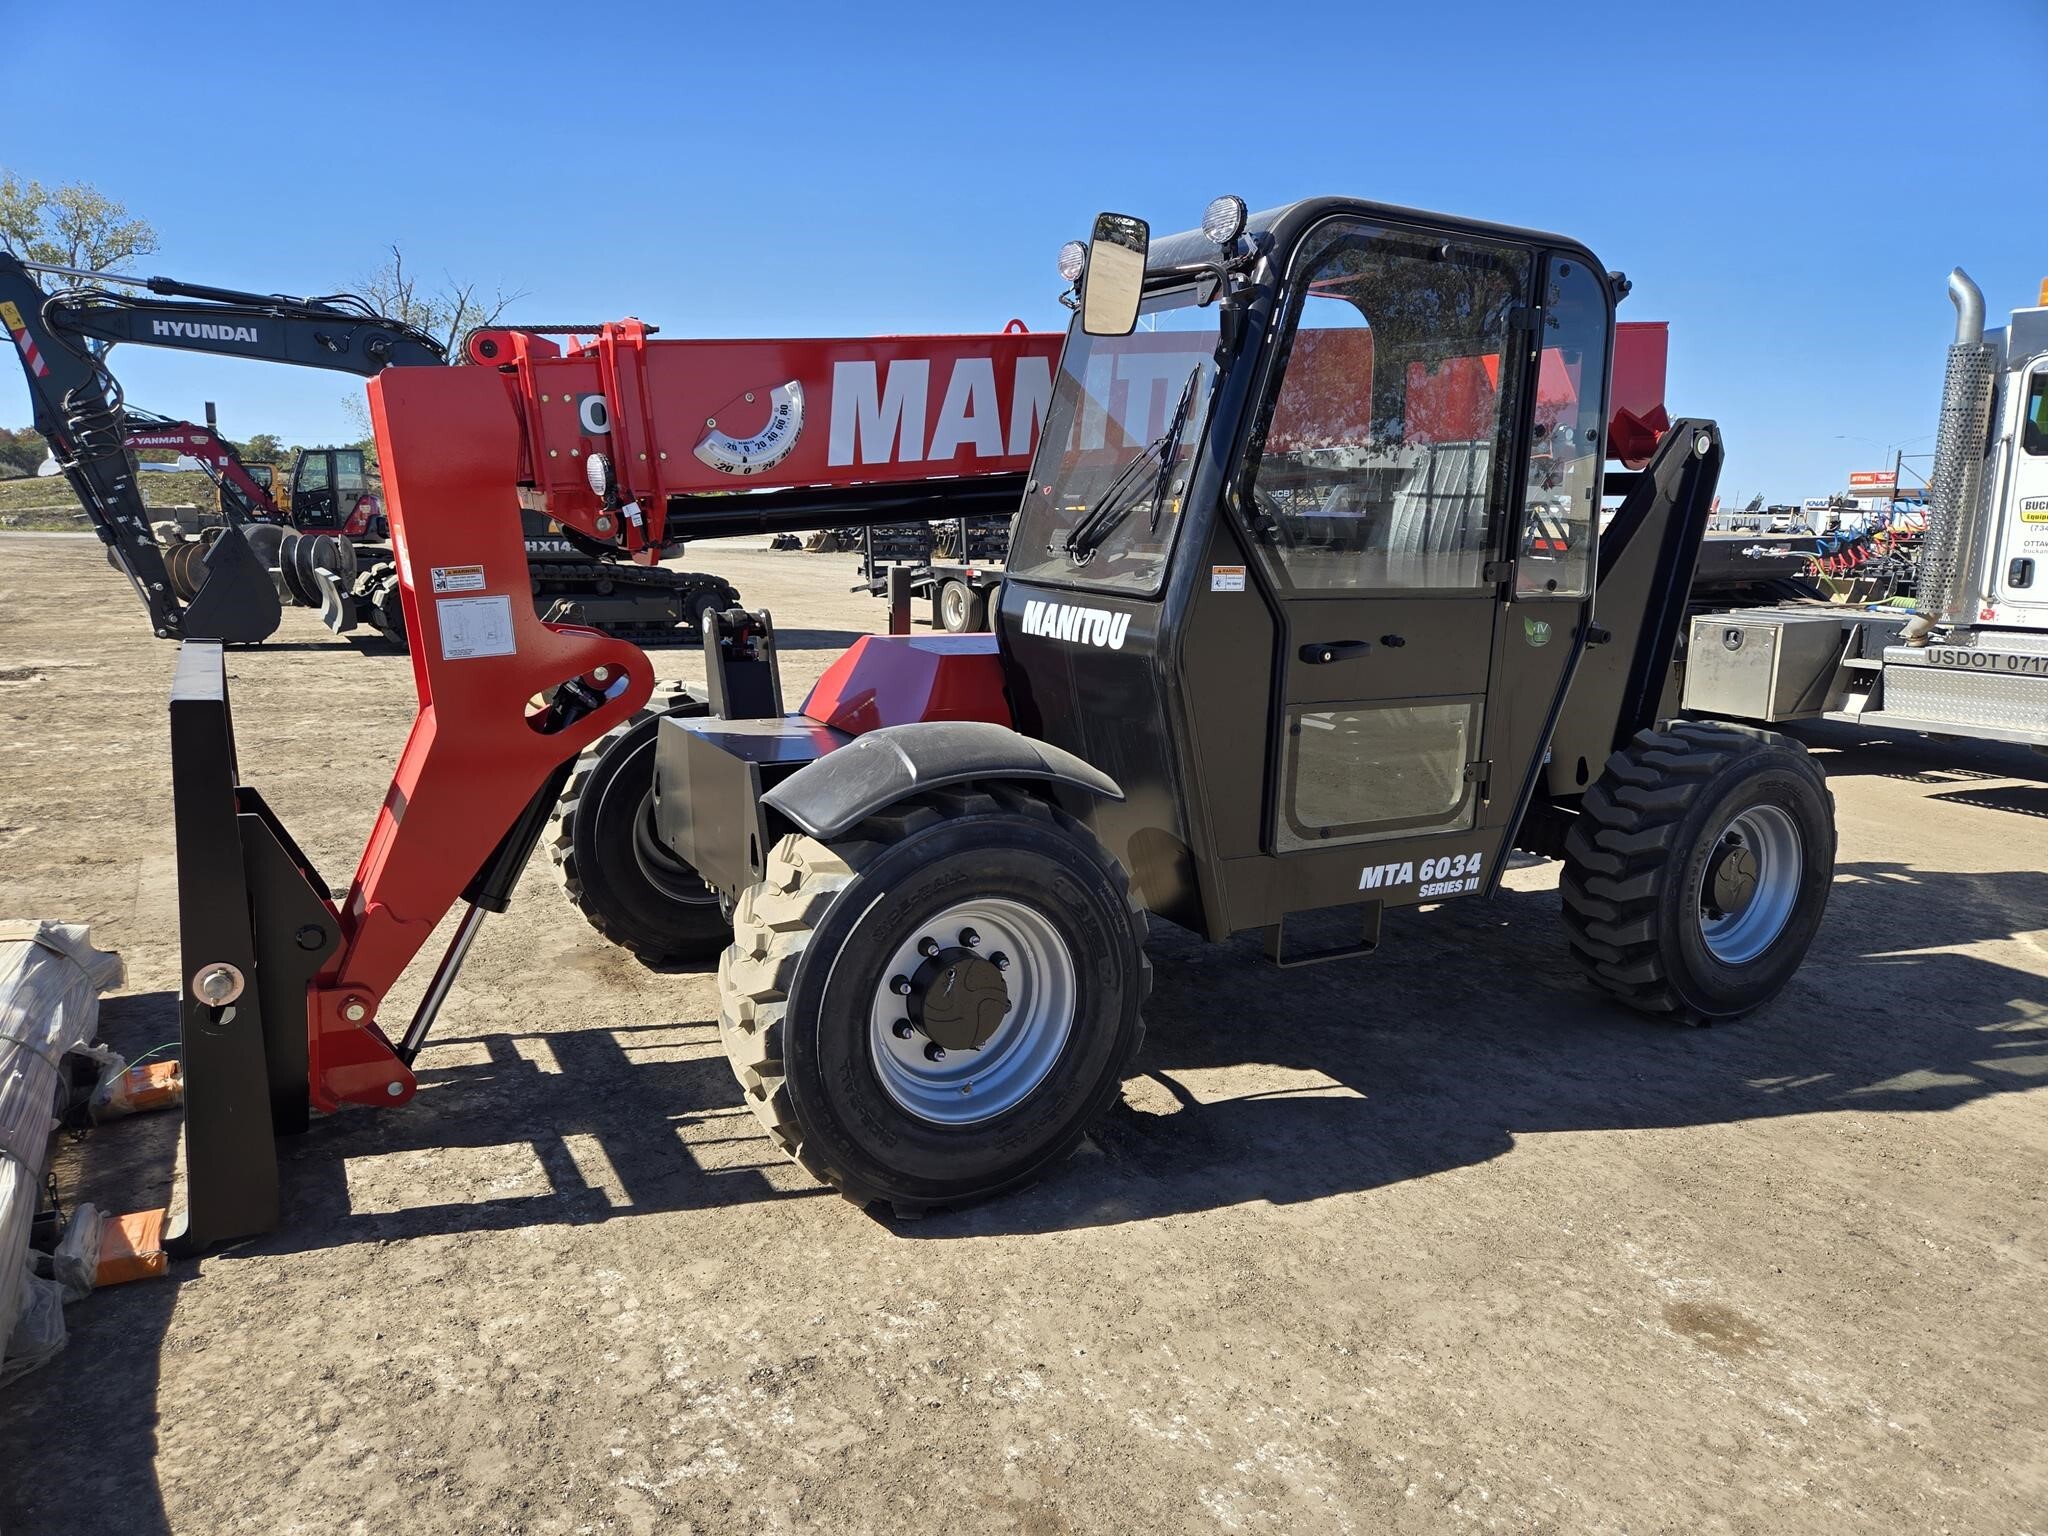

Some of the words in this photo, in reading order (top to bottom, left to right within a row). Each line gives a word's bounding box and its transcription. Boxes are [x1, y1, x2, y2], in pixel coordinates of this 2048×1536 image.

[153, 320, 258, 342] HYUNDAI
[780, 404, 788, 415] 80
[827, 351, 1217, 467] MANITO
[775, 419, 786, 430] 60
[136, 436, 184, 444] YANMAR
[767, 431, 778, 442] 40
[754, 440, 767, 449] 20
[714, 462, 734, 473] -20
[762, 460, 775, 471] 20
[1271, 489, 1290, 498] JCB
[525, 541, 580, 552] HX14
[1021, 600, 1132, 650] MANITOU
[1536, 623, 1549, 633] IV
[1928, 650, 2001, 669] USDOT
[2007, 655, 2048, 673] 0717
[1359, 862, 1413, 890] MTA
[1419, 852, 1482, 881] 6034
[1418, 879, 1463, 898] SERIES
[1464, 876, 1480, 891] III
